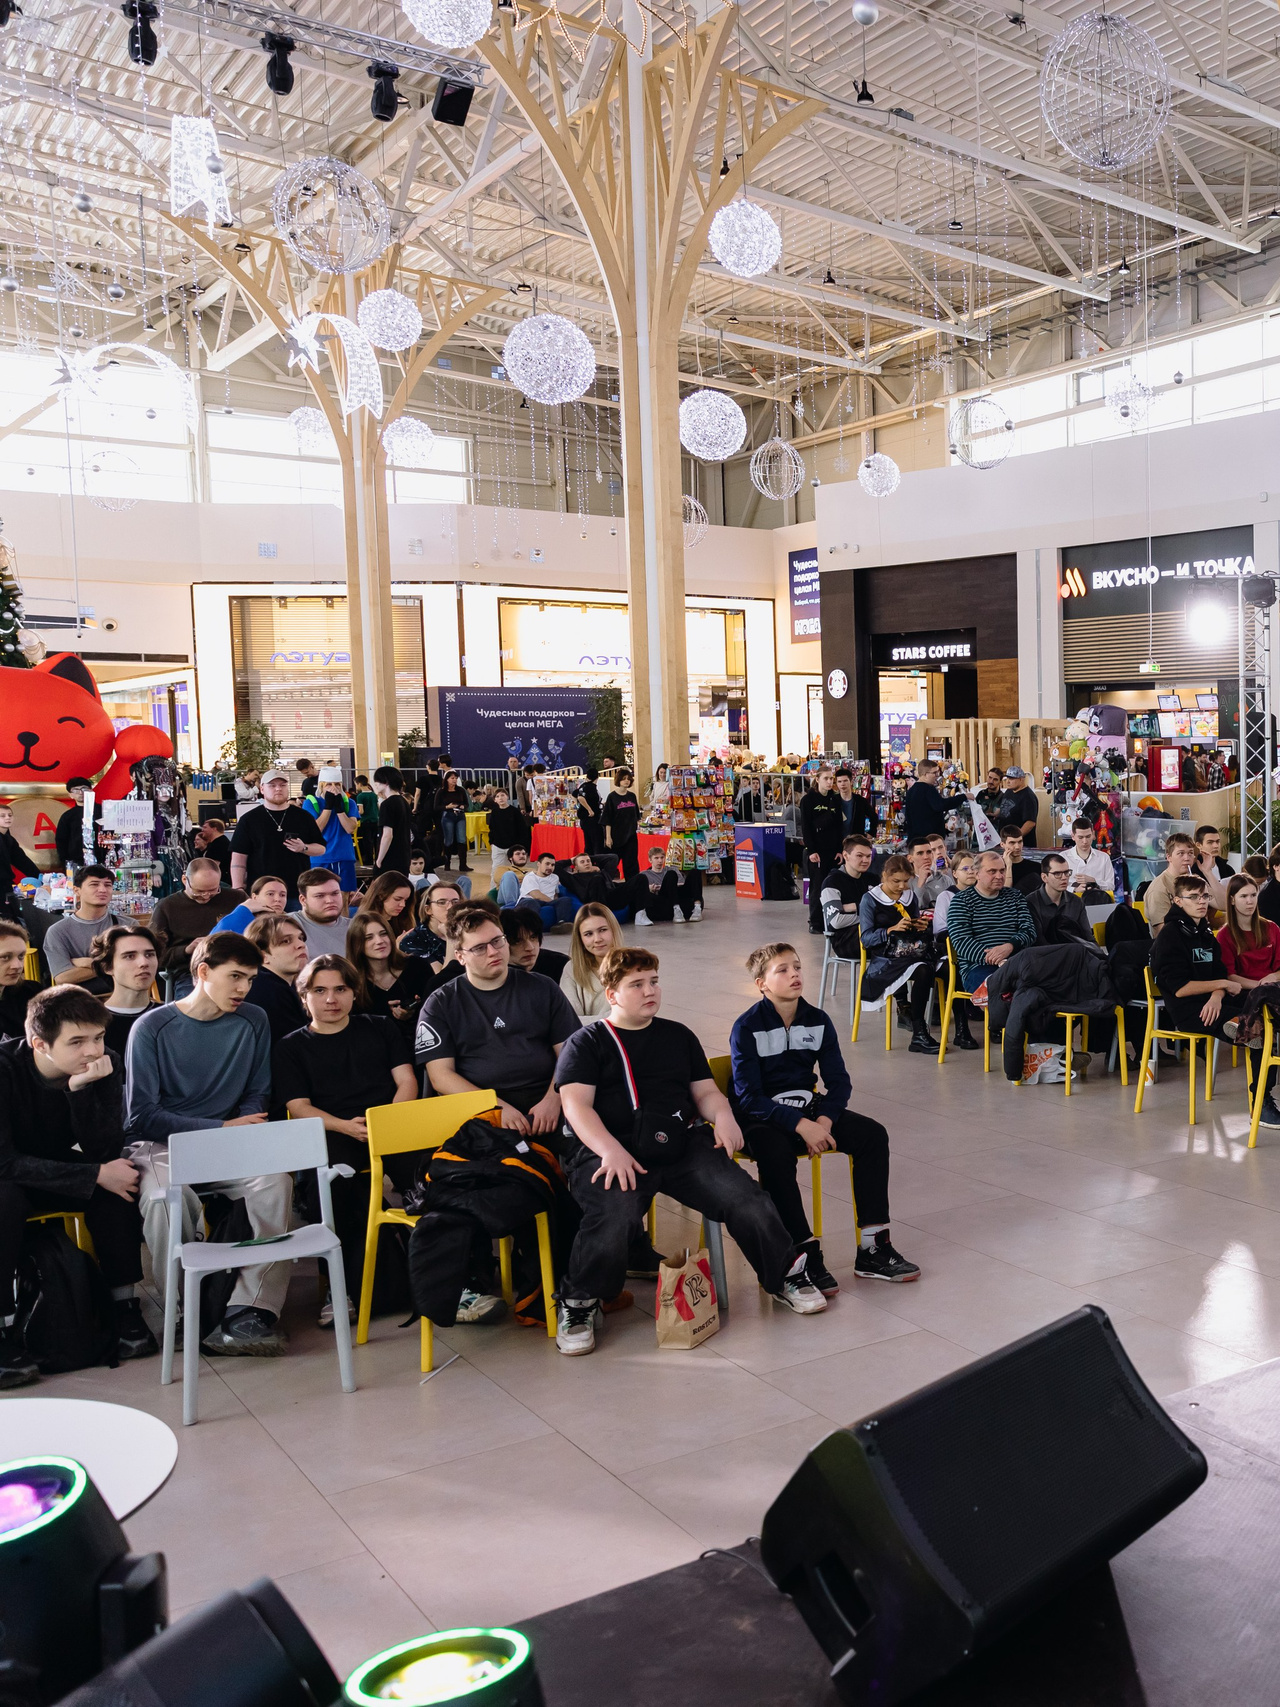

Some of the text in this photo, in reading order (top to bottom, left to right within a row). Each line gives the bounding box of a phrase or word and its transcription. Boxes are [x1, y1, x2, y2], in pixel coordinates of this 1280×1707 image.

[1092, 566, 1160, 589] ВКУСНО
[1193, 556, 1256, 576] ТОЧКА
[892, 644, 971, 660] STARS COFFEE
[476, 708, 527, 719] Чудесных
[528, 710, 575, 718] подарков
[504, 719, 564, 729] целая МЕГА
[765, 827, 783, 835] RT.RU
